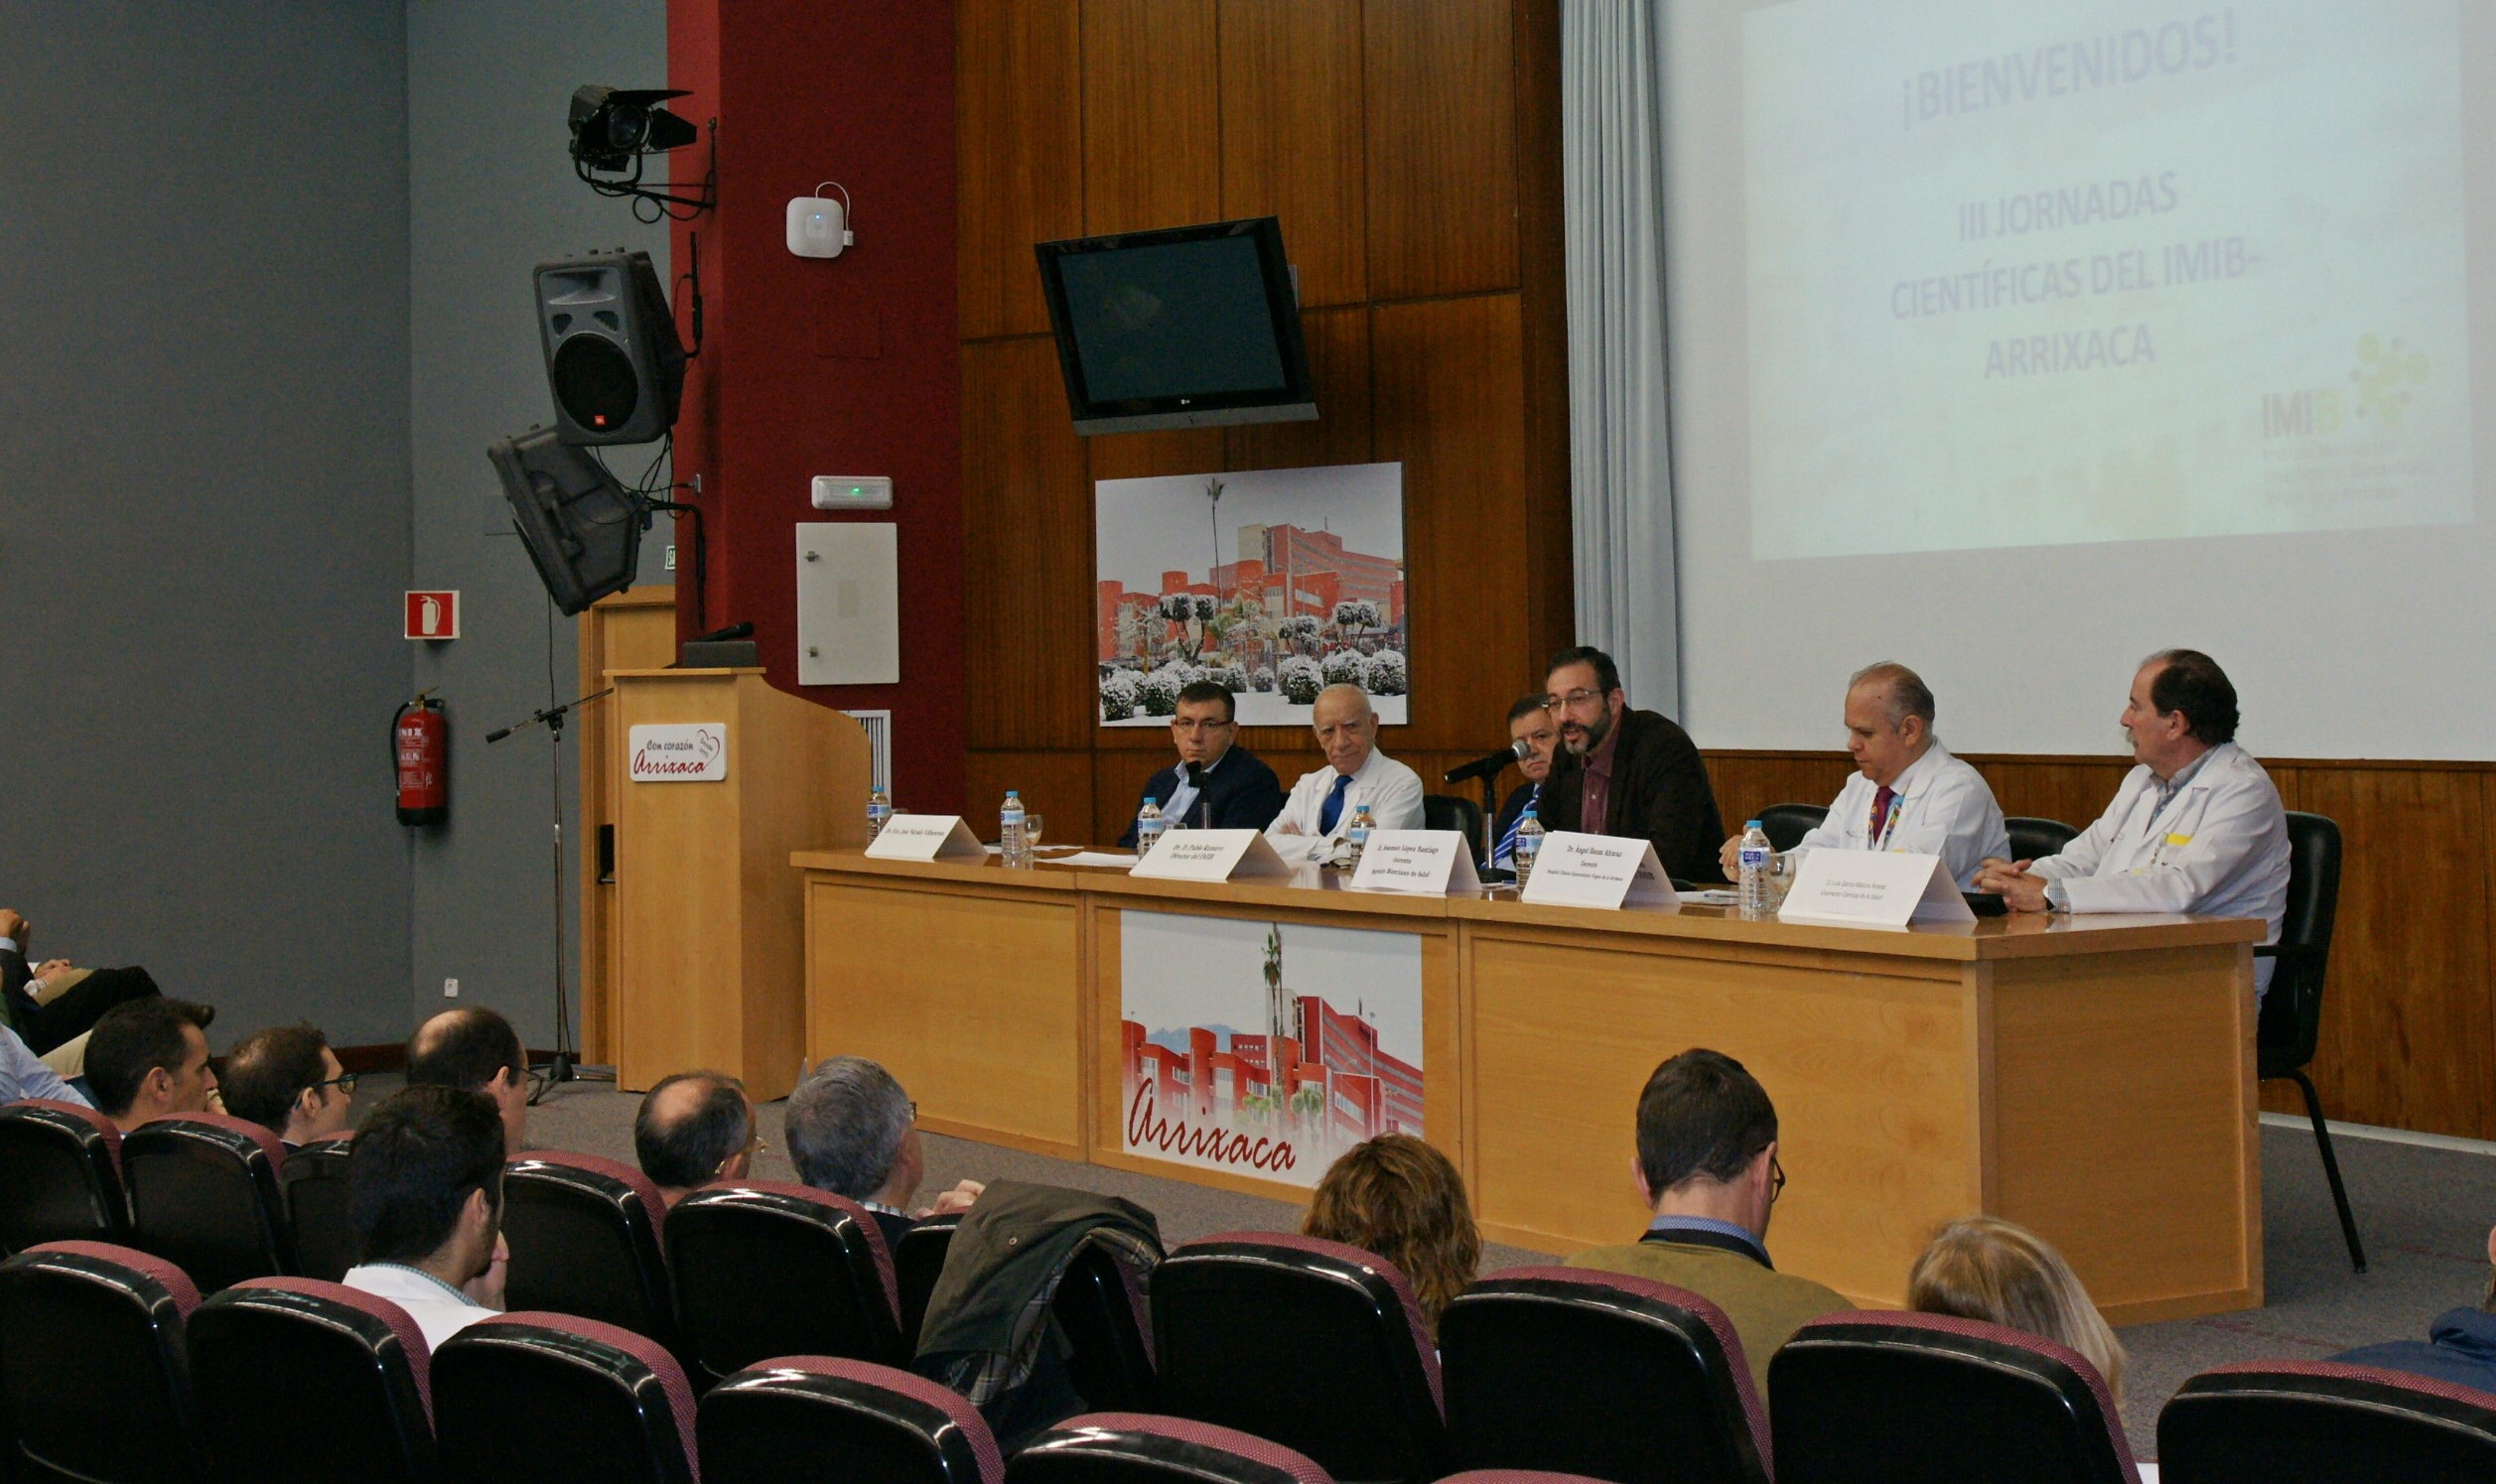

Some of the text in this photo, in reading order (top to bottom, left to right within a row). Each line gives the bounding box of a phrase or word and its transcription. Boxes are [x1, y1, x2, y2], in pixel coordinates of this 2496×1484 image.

[1900, 6, 2237, 132] ¡BIENVENIDOS!
[1957, 170, 2179, 242] III JORNADAS
[1889, 234, 2262, 320] CIENTÍFICAS DEL IMIB-
[1983, 323, 2155, 380] ARRIXACA
[633, 748, 705, 775] Arrixaca
[646, 739, 694, 751] Con corazón
[1128, 1077, 1297, 1172] Arrixaca
